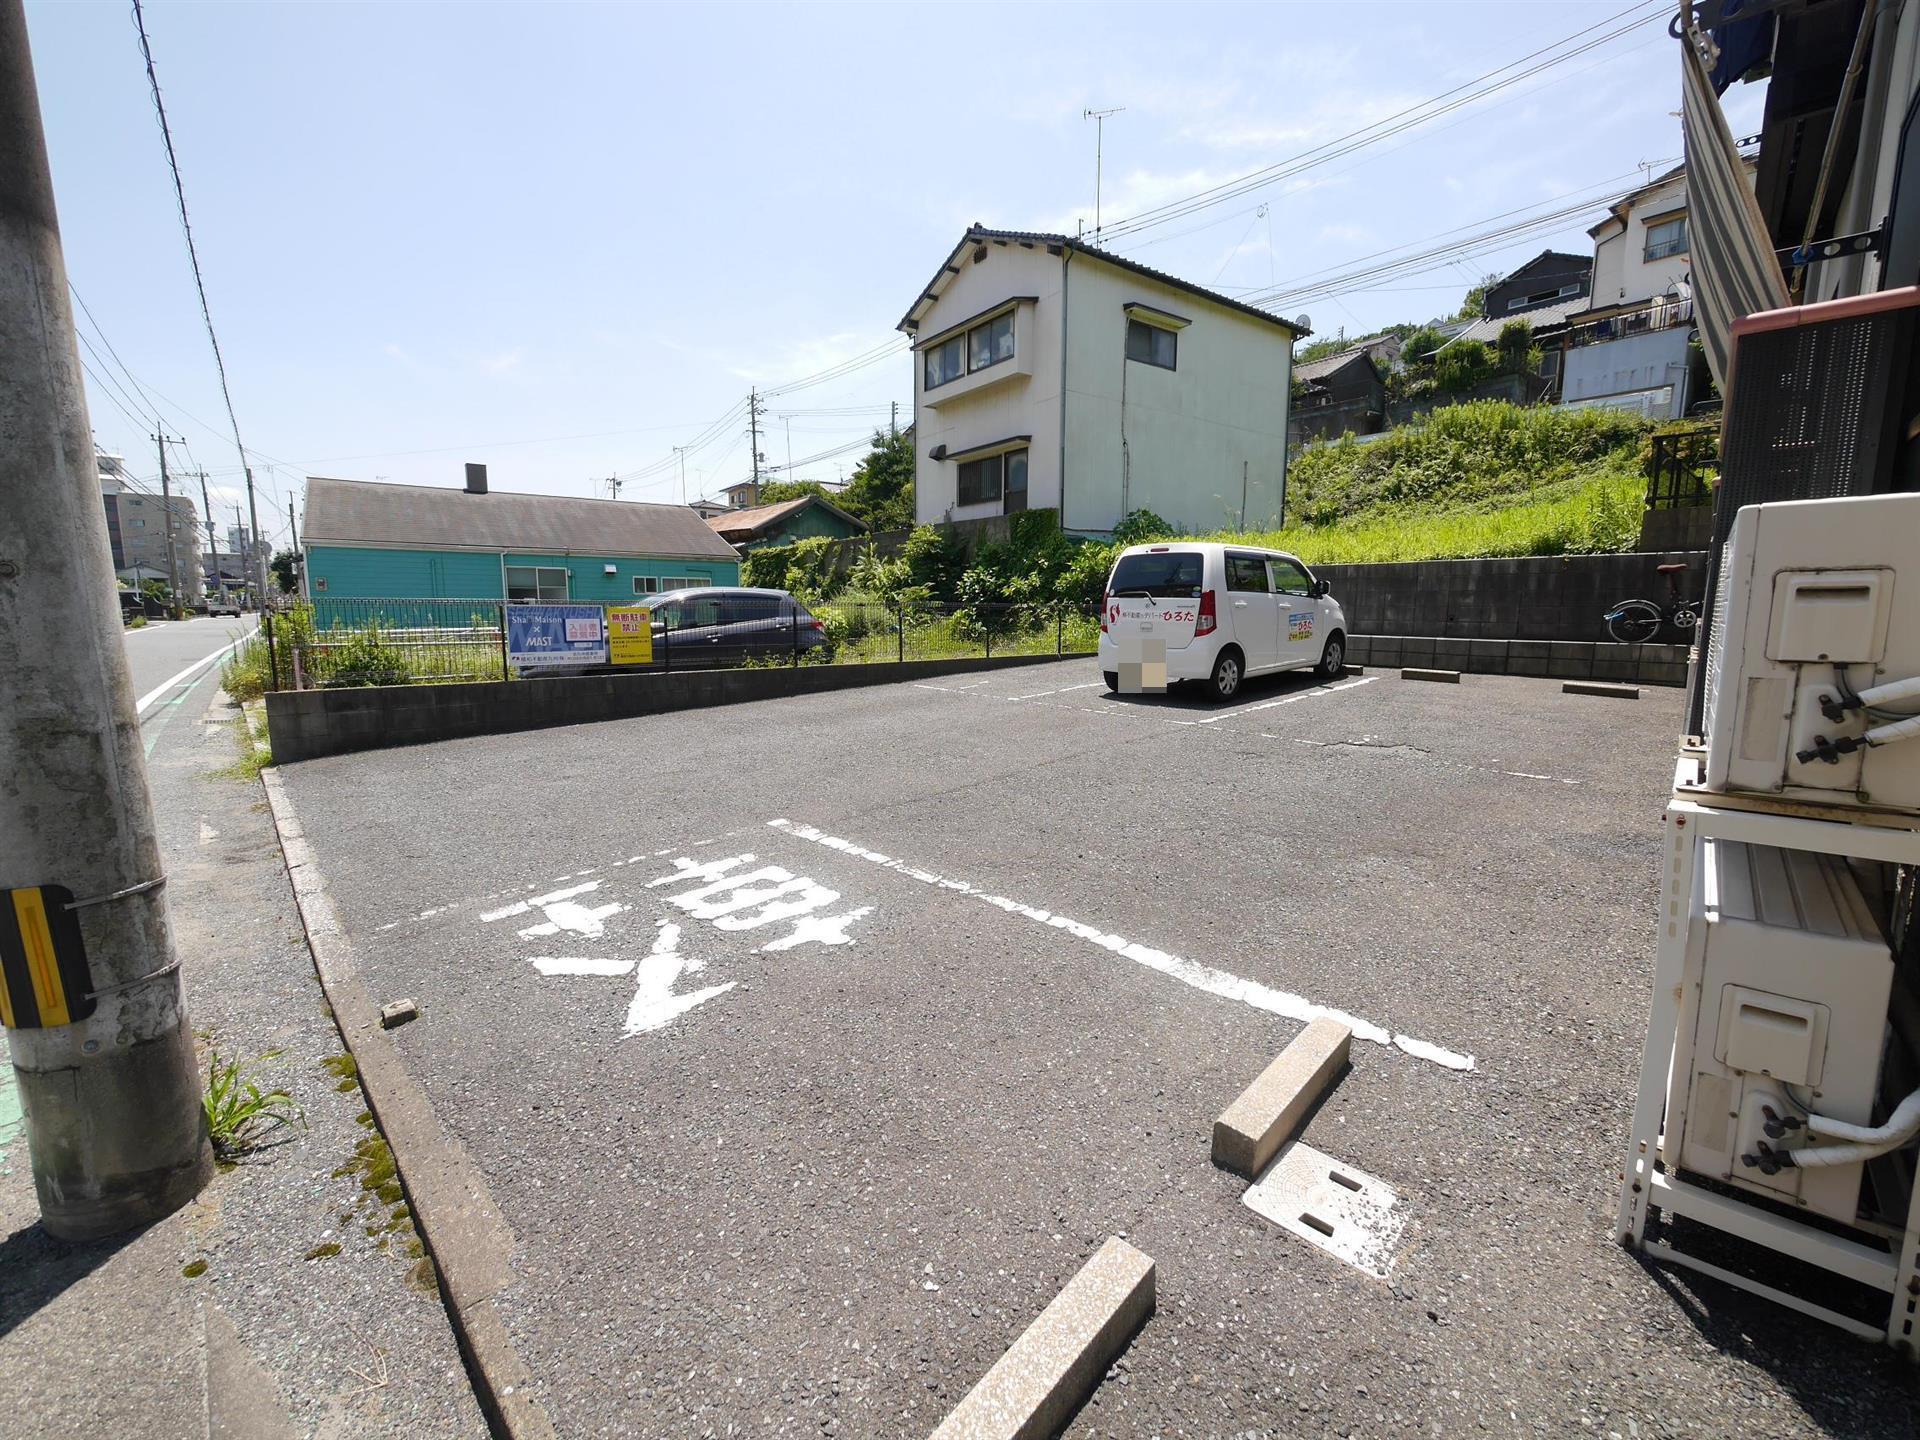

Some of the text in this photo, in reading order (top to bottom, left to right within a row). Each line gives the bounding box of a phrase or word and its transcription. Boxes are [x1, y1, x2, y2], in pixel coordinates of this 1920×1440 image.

[611, 613, 647, 622] 無断駐車
[1162, 611, 1195, 622] ひろた
[622, 623, 640, 632] 禁止
[526, 637, 553, 647] MAST
[480, 853, 875, 1038] 軽
